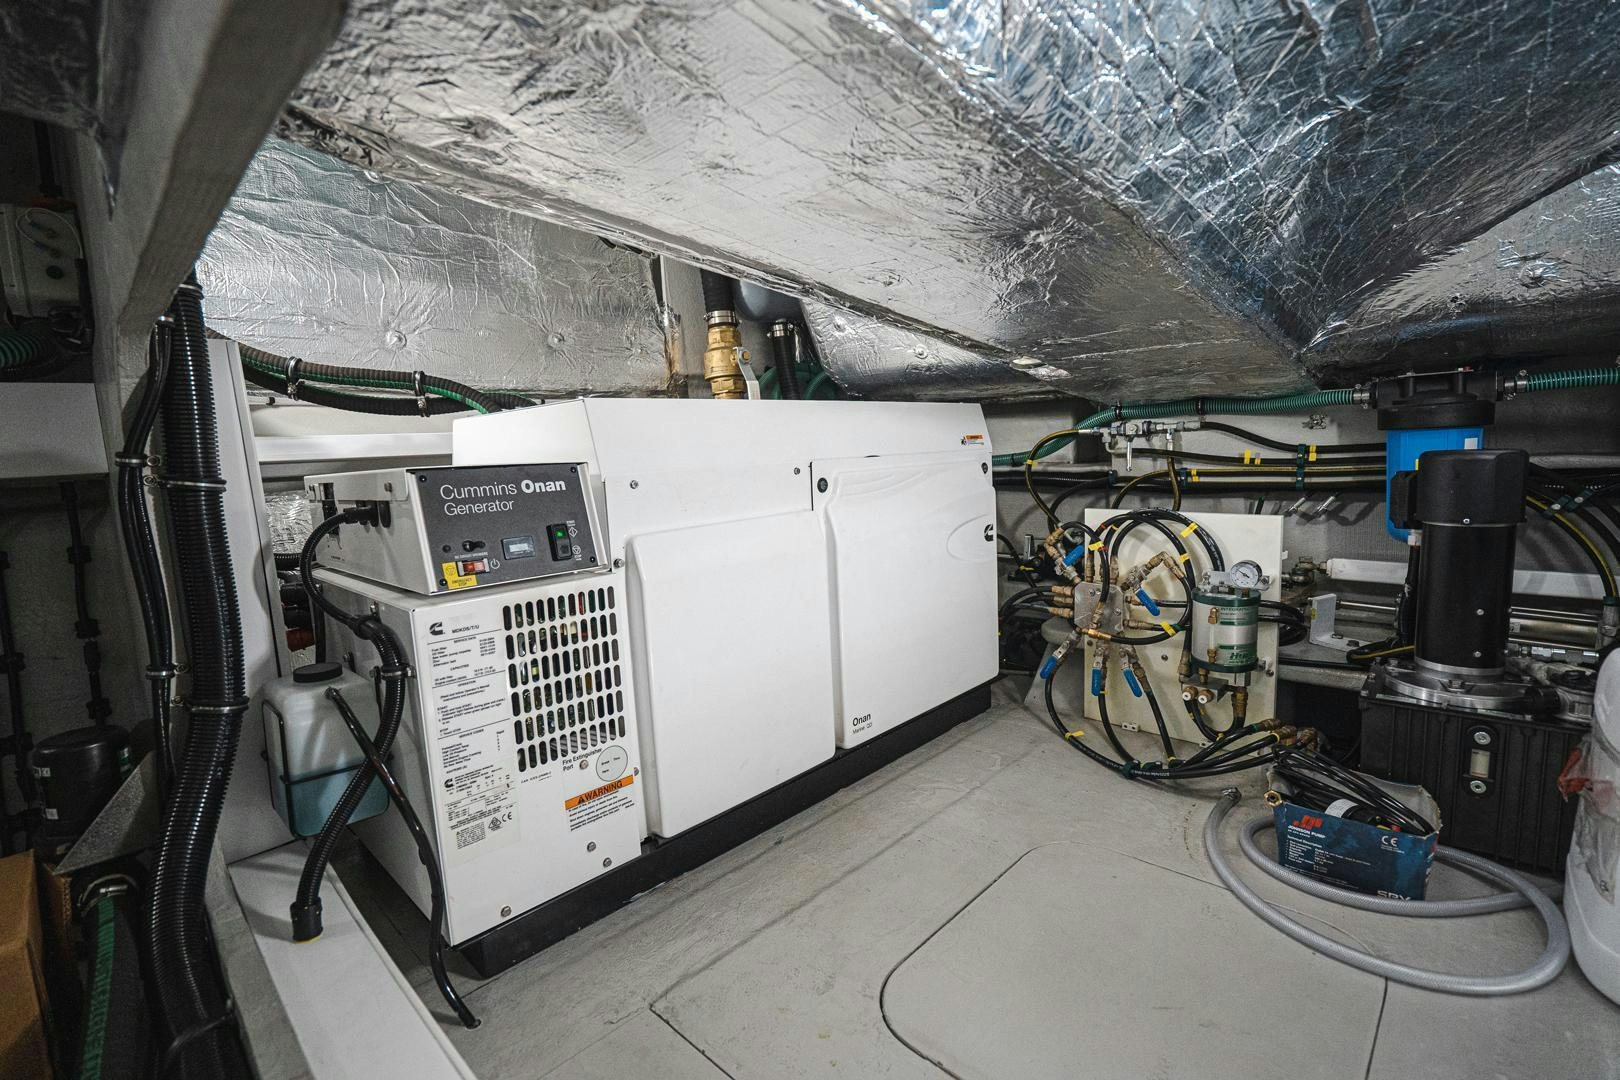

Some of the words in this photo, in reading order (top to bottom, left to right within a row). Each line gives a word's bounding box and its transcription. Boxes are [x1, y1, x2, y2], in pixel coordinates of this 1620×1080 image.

[440, 482, 517, 500] Cummins
[521, 479, 567, 494] Onan
[444, 500, 514, 516] Generator
[852, 713, 871, 726] Onan
[572, 748, 602, 762] Extinguisher
[584, 780, 623, 801] WARNING
